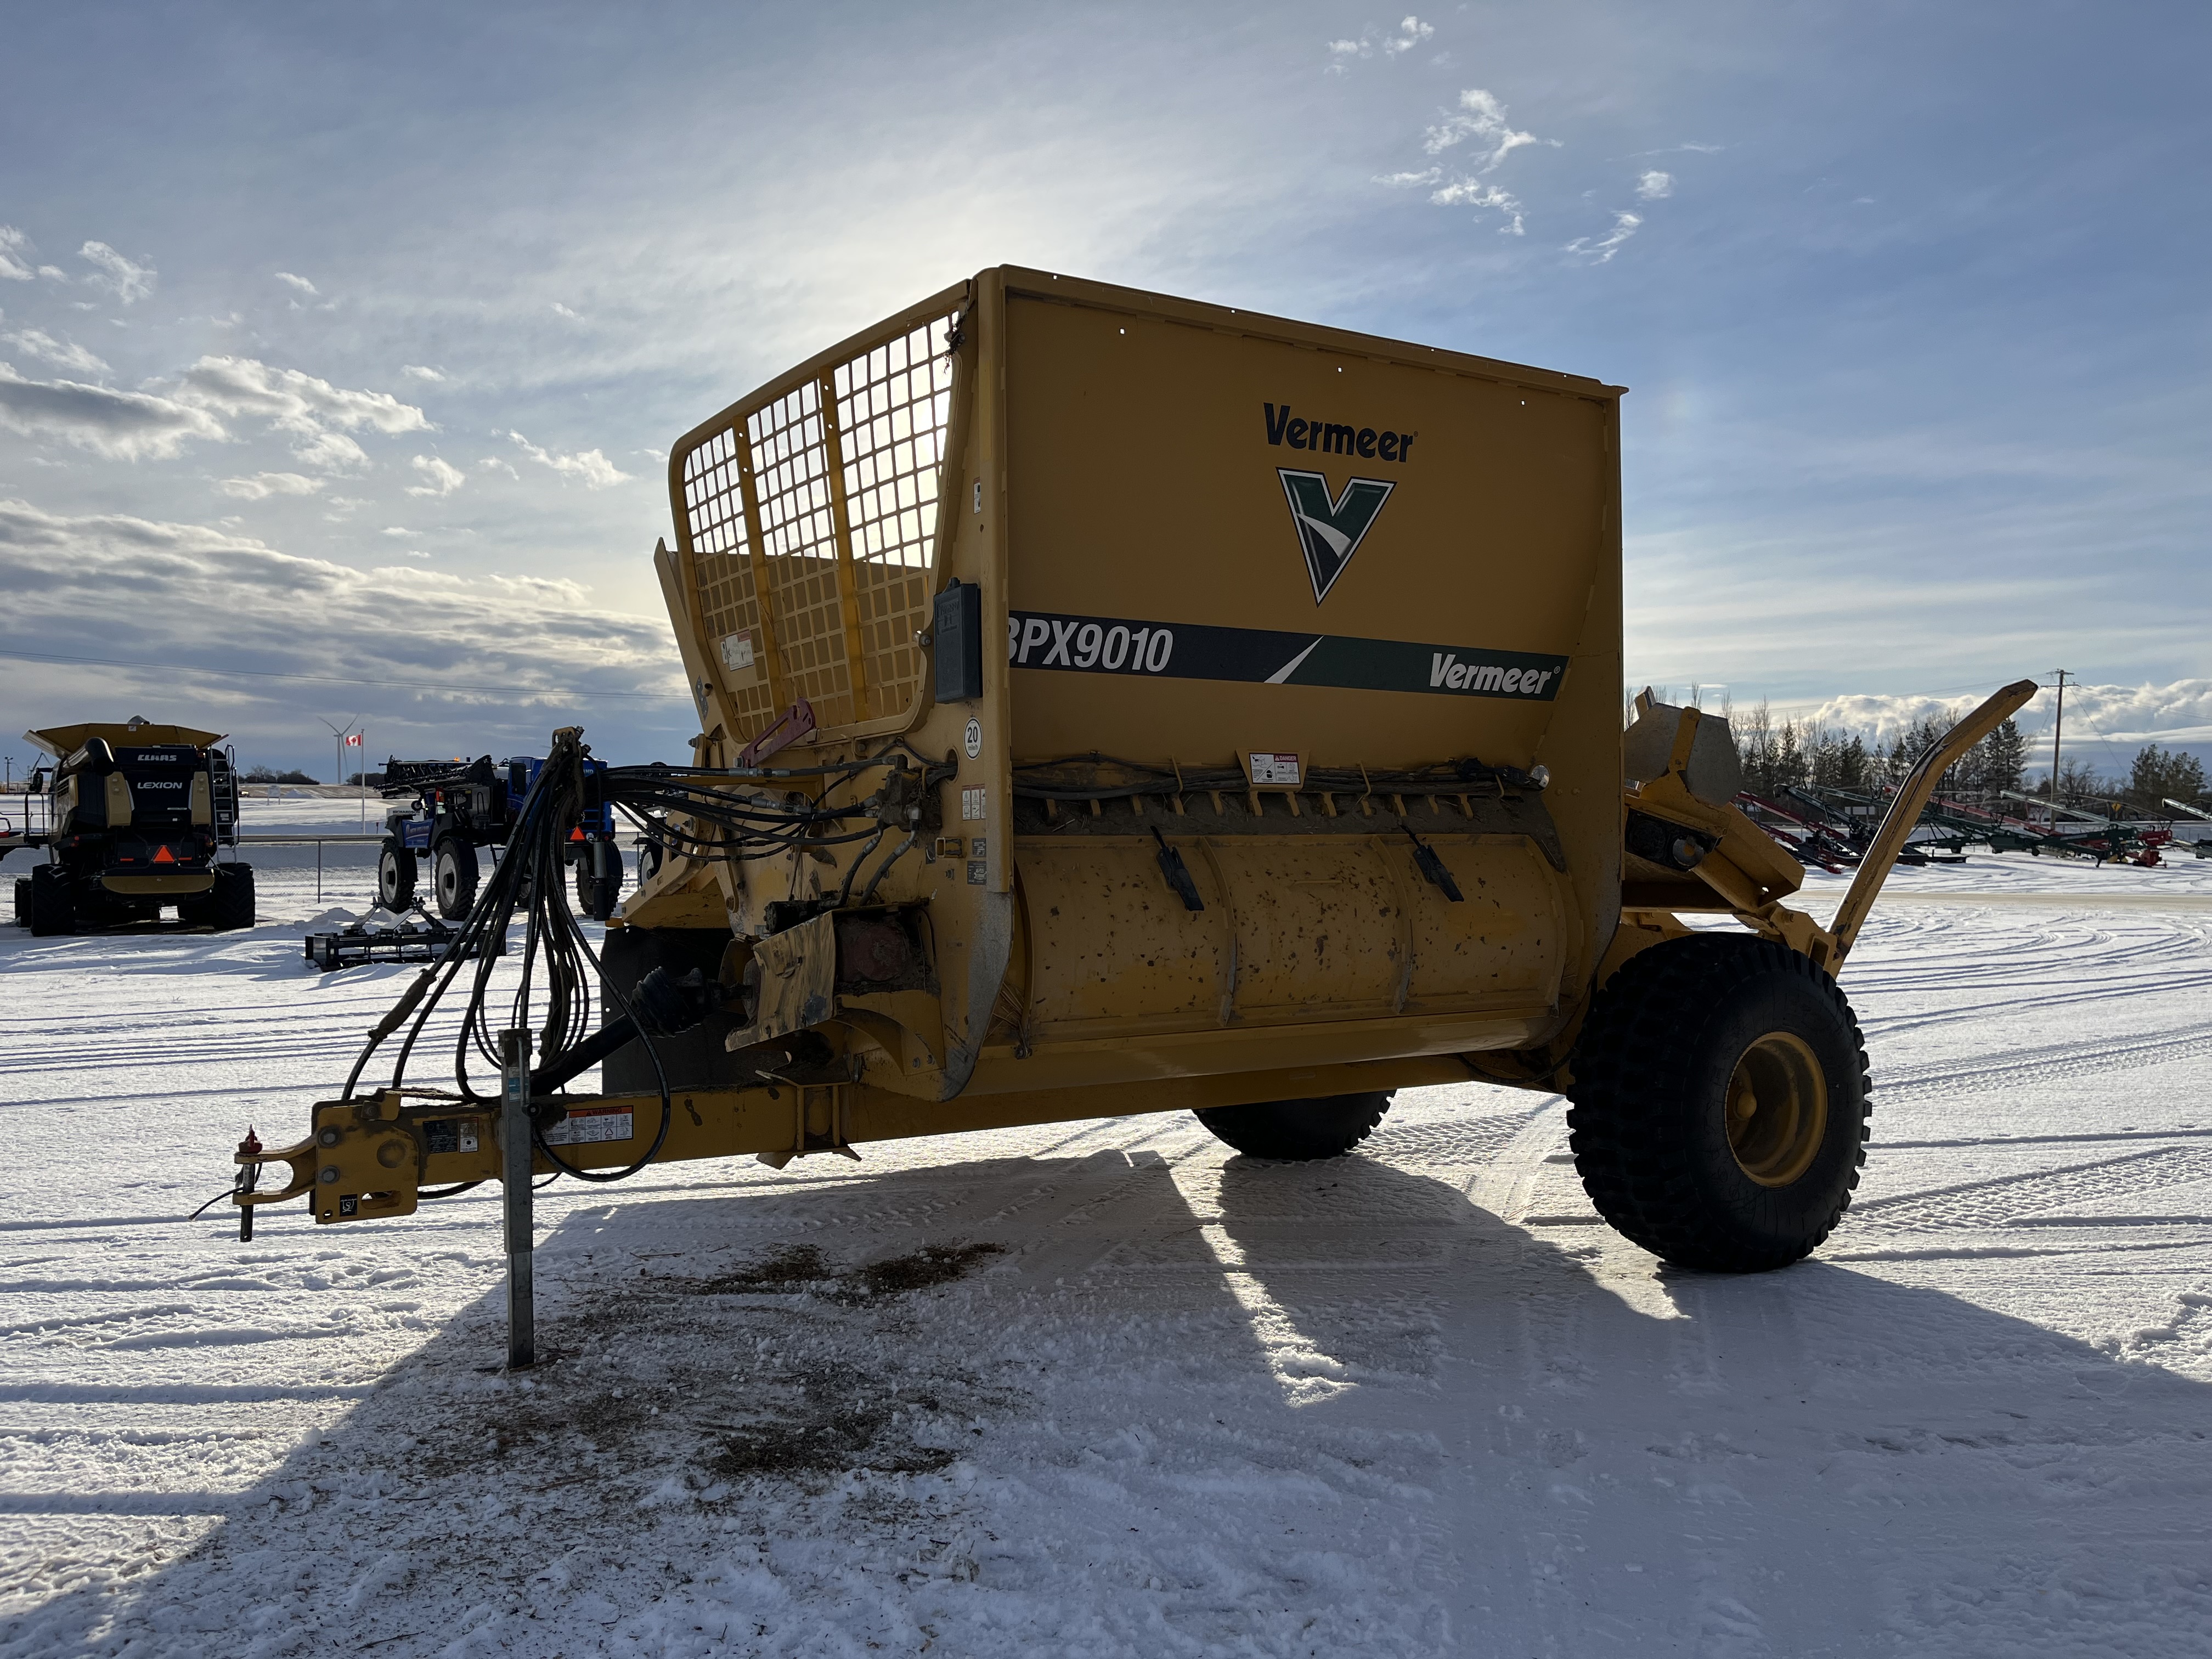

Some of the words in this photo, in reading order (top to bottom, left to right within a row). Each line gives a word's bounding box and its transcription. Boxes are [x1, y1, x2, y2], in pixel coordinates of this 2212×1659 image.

[1263, 402, 1414, 462] Vermeer
[1430, 653, 1552, 694] Vermeer
[967, 726, 978, 743] 20
